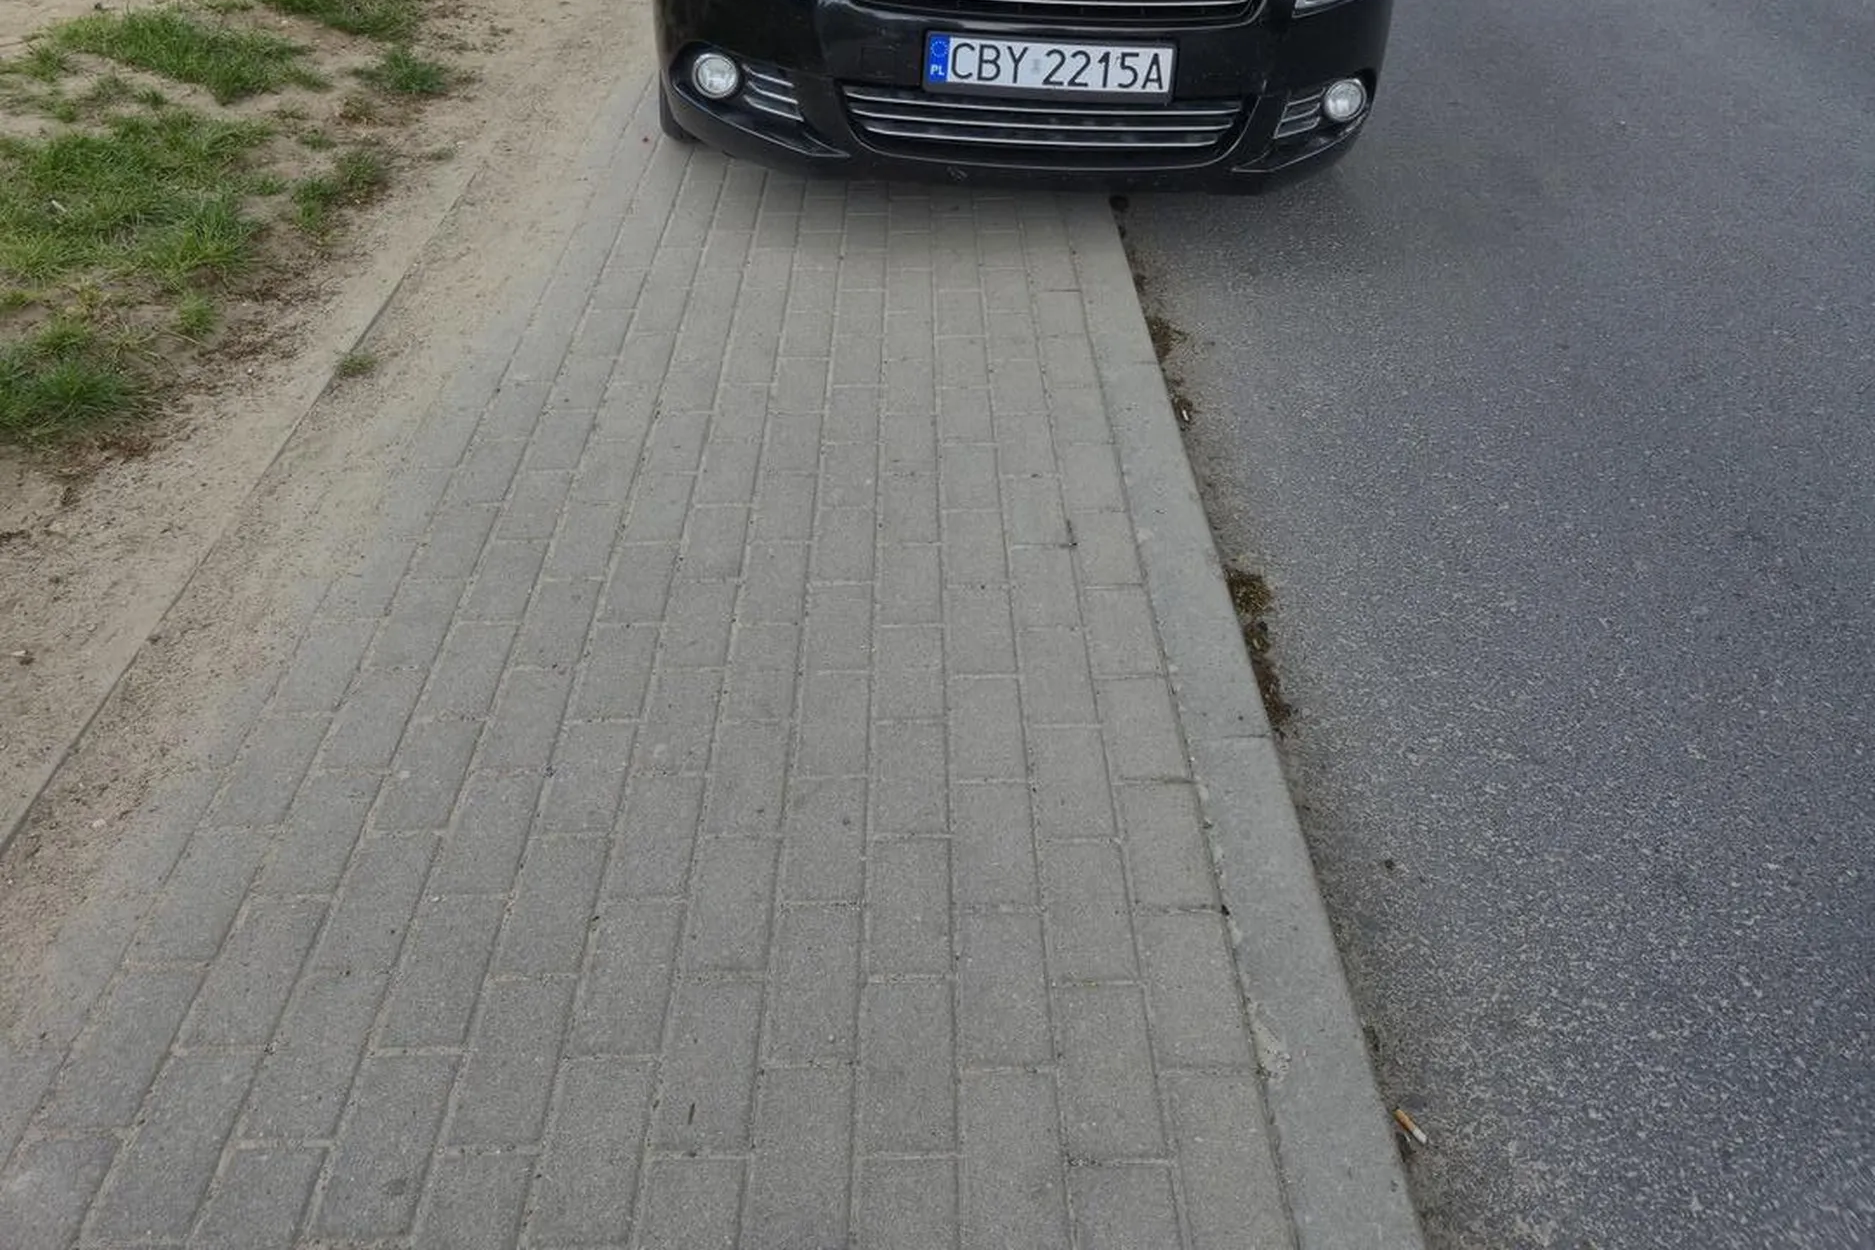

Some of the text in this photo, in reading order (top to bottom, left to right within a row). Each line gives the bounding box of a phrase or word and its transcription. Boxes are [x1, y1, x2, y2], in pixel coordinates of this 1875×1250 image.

[930, 63, 945, 76] PL
[951, 42, 1163, 90] CBY 2215A
